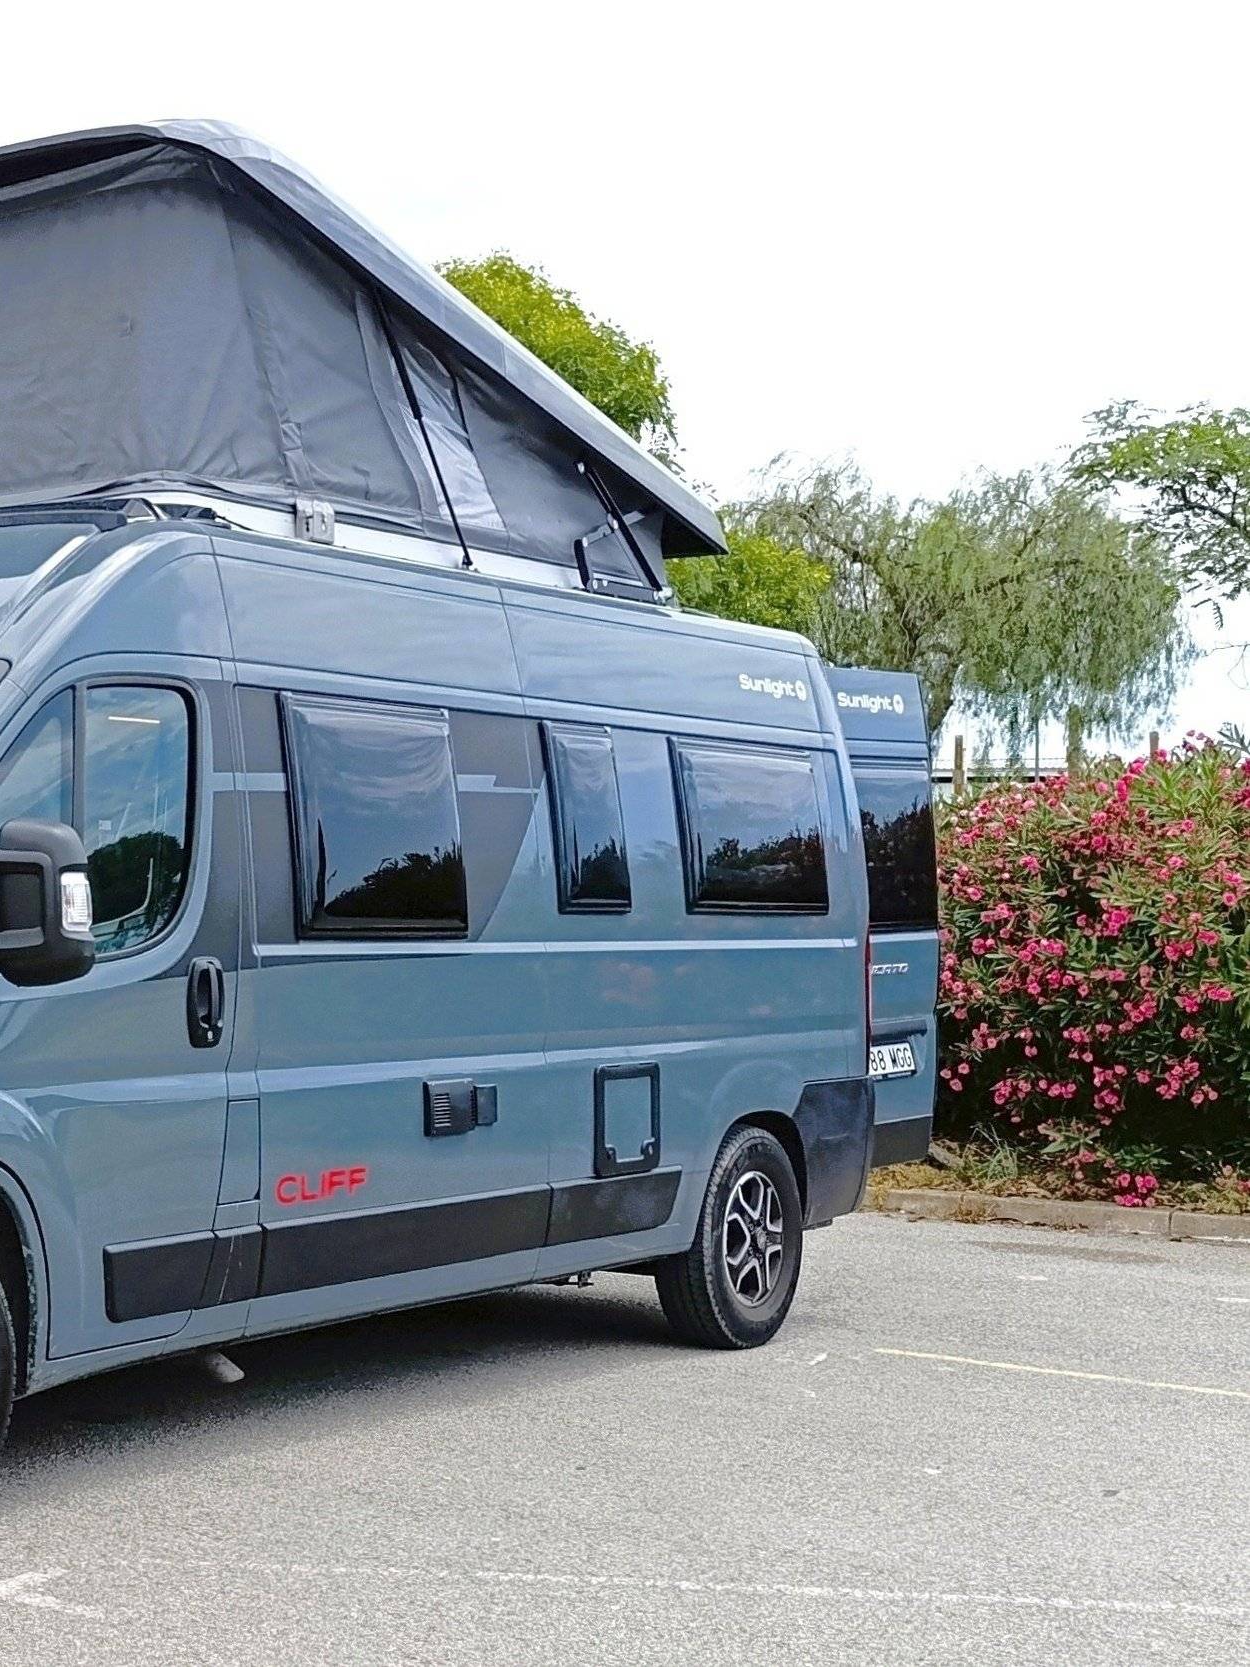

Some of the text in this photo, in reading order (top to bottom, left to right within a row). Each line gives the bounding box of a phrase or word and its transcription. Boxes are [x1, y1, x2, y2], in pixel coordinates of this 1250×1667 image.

[739, 674, 796, 699] Sunlight
[837, 692, 893, 713] Sunlight
[276, 1167, 367, 1204] CLIFF
